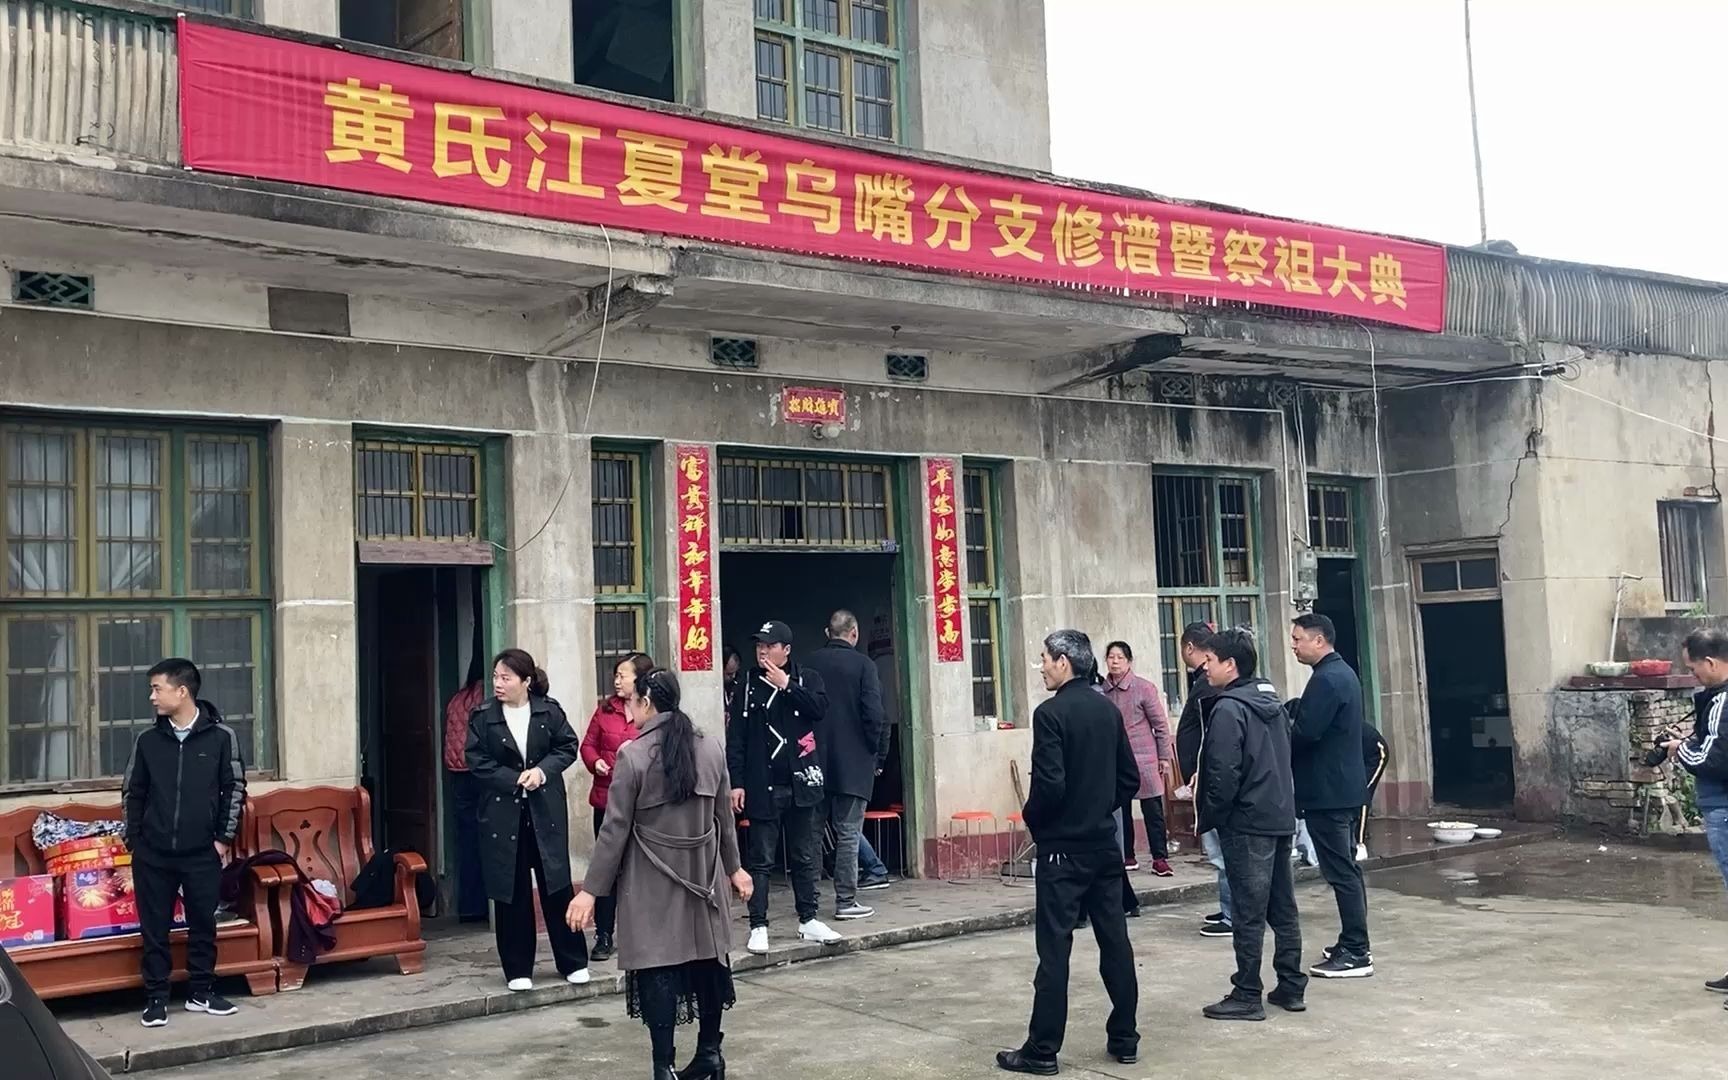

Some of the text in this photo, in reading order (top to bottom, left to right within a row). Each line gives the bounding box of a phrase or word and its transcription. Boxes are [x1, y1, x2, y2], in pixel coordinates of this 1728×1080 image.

[323, 77, 1408, 310] 黄氏江夏堂乌嘴分支修谱暨祭祖大典
